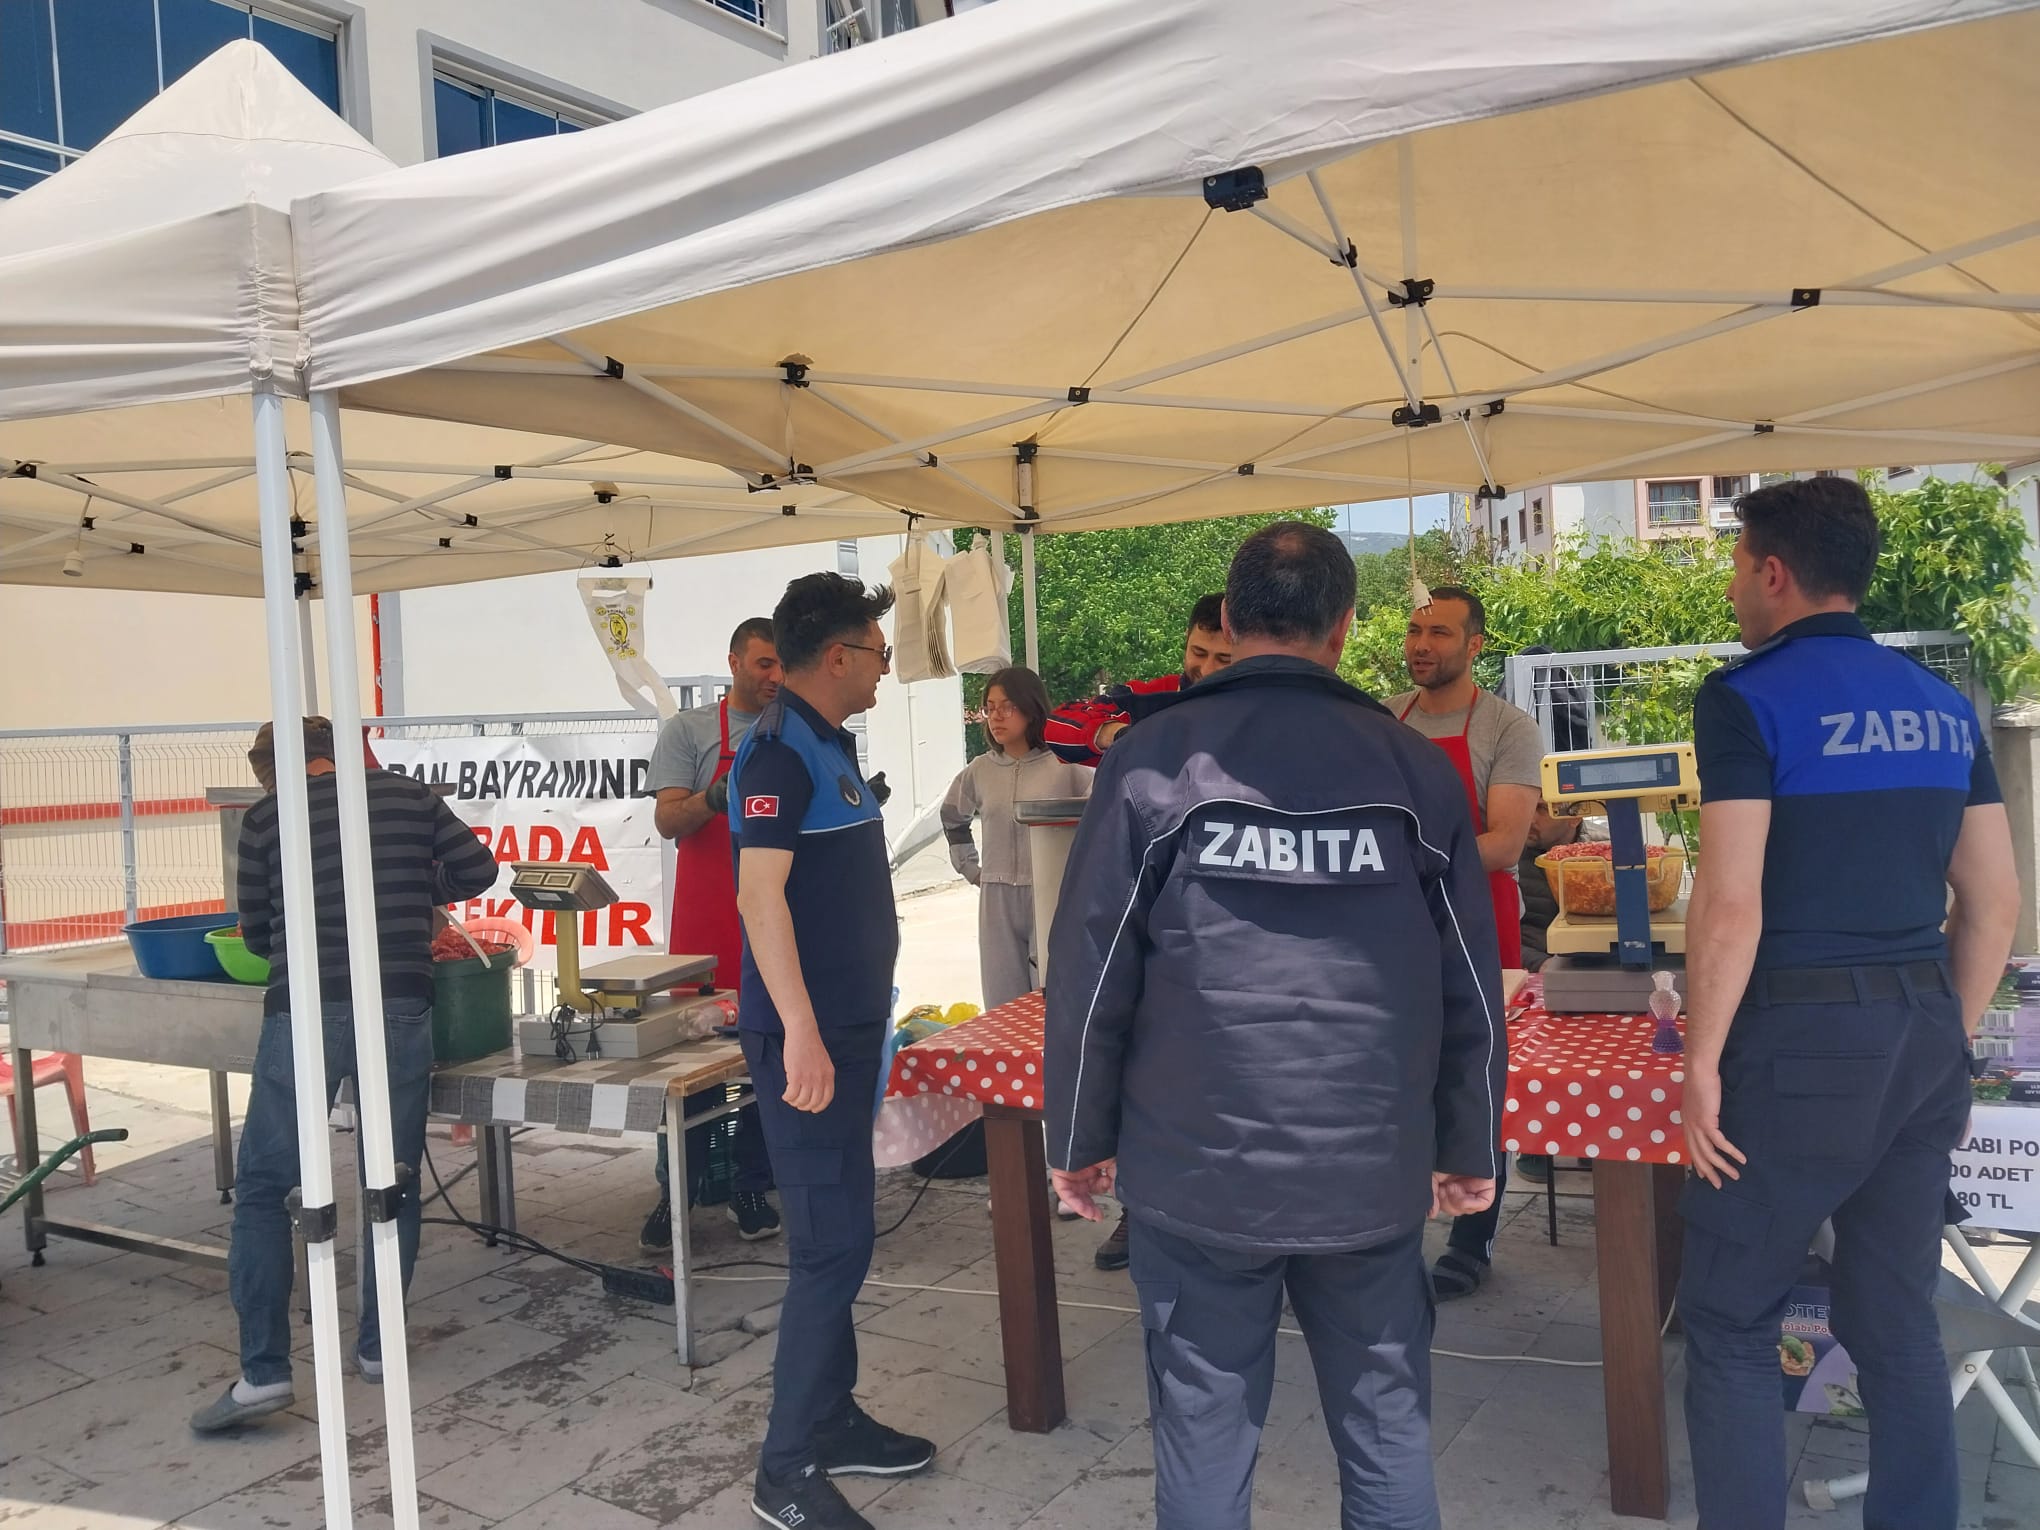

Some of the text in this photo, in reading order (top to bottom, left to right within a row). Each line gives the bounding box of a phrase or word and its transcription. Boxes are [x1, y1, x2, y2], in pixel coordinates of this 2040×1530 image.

[1820, 710, 1975, 760] ZABITA
[1199, 821, 1386, 873] ZABITA
[2009, 1139, 2040, 1157] PO
[1977, 1166, 2034, 1182] ADET
[1986, 1193, 2014, 1209] TL
